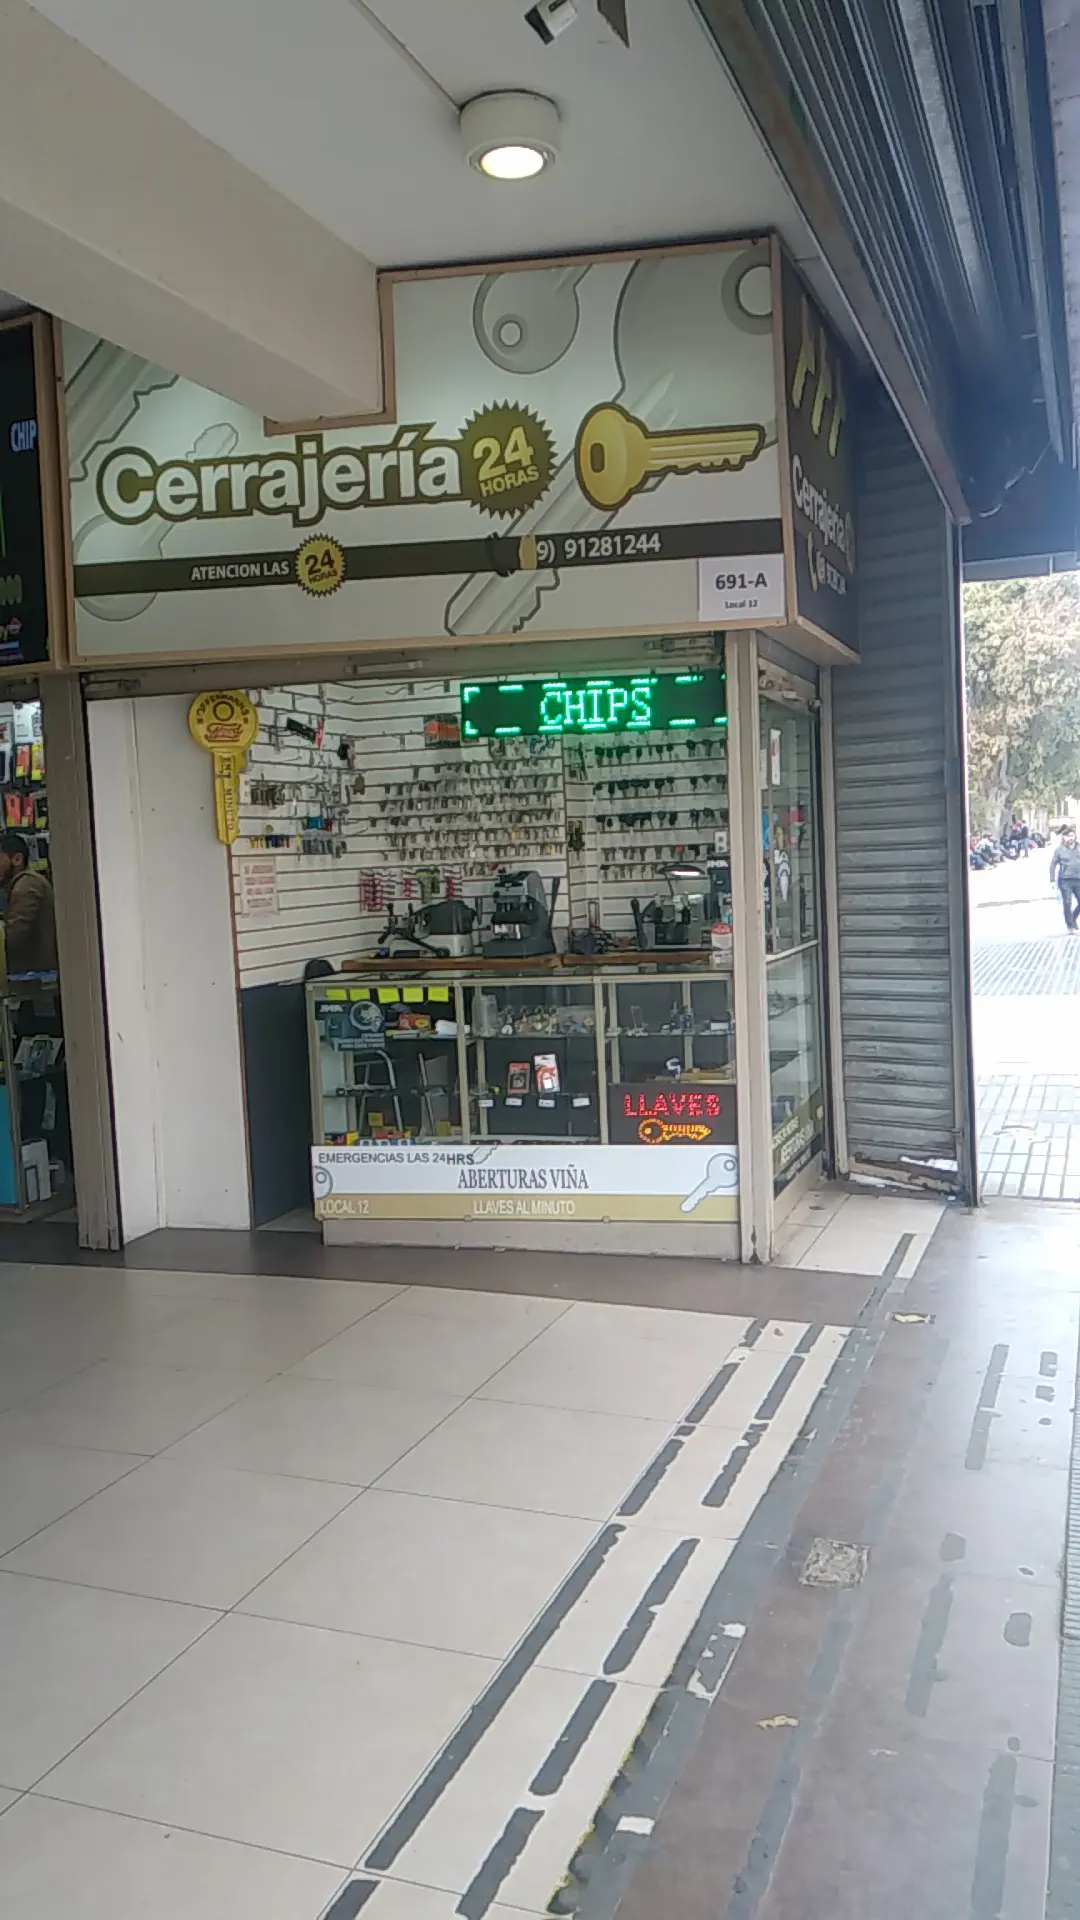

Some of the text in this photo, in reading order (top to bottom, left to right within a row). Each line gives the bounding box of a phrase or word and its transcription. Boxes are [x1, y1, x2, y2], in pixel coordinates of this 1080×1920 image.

[473, 425, 535, 482] 24
[101, 429, 463, 521] Cerrajería
[479, 465, 540, 498] HORAS
[564, 532, 662, 560] 91281244
[190, 560, 290, 581] ATENCION LAS
[304, 548, 336, 576] 24
[308, 569, 338, 585] HORAS
[715, 572, 768, 591] 691-A
[724, 600, 746, 609] Local
[540, 686, 651, 725] CHIPS
[624, 1093, 721, 1117] LLAVES
[318, 1152, 404, 1164] EMERGENCIAS
[407, 1152, 430, 1163] LAS
[457, 1164, 589, 1190] ABERTURAS VIÑA
[320, 1200, 369, 1214] LOCAL 12
[473, 1200, 576, 1215] LLAVES AL MINUTO
